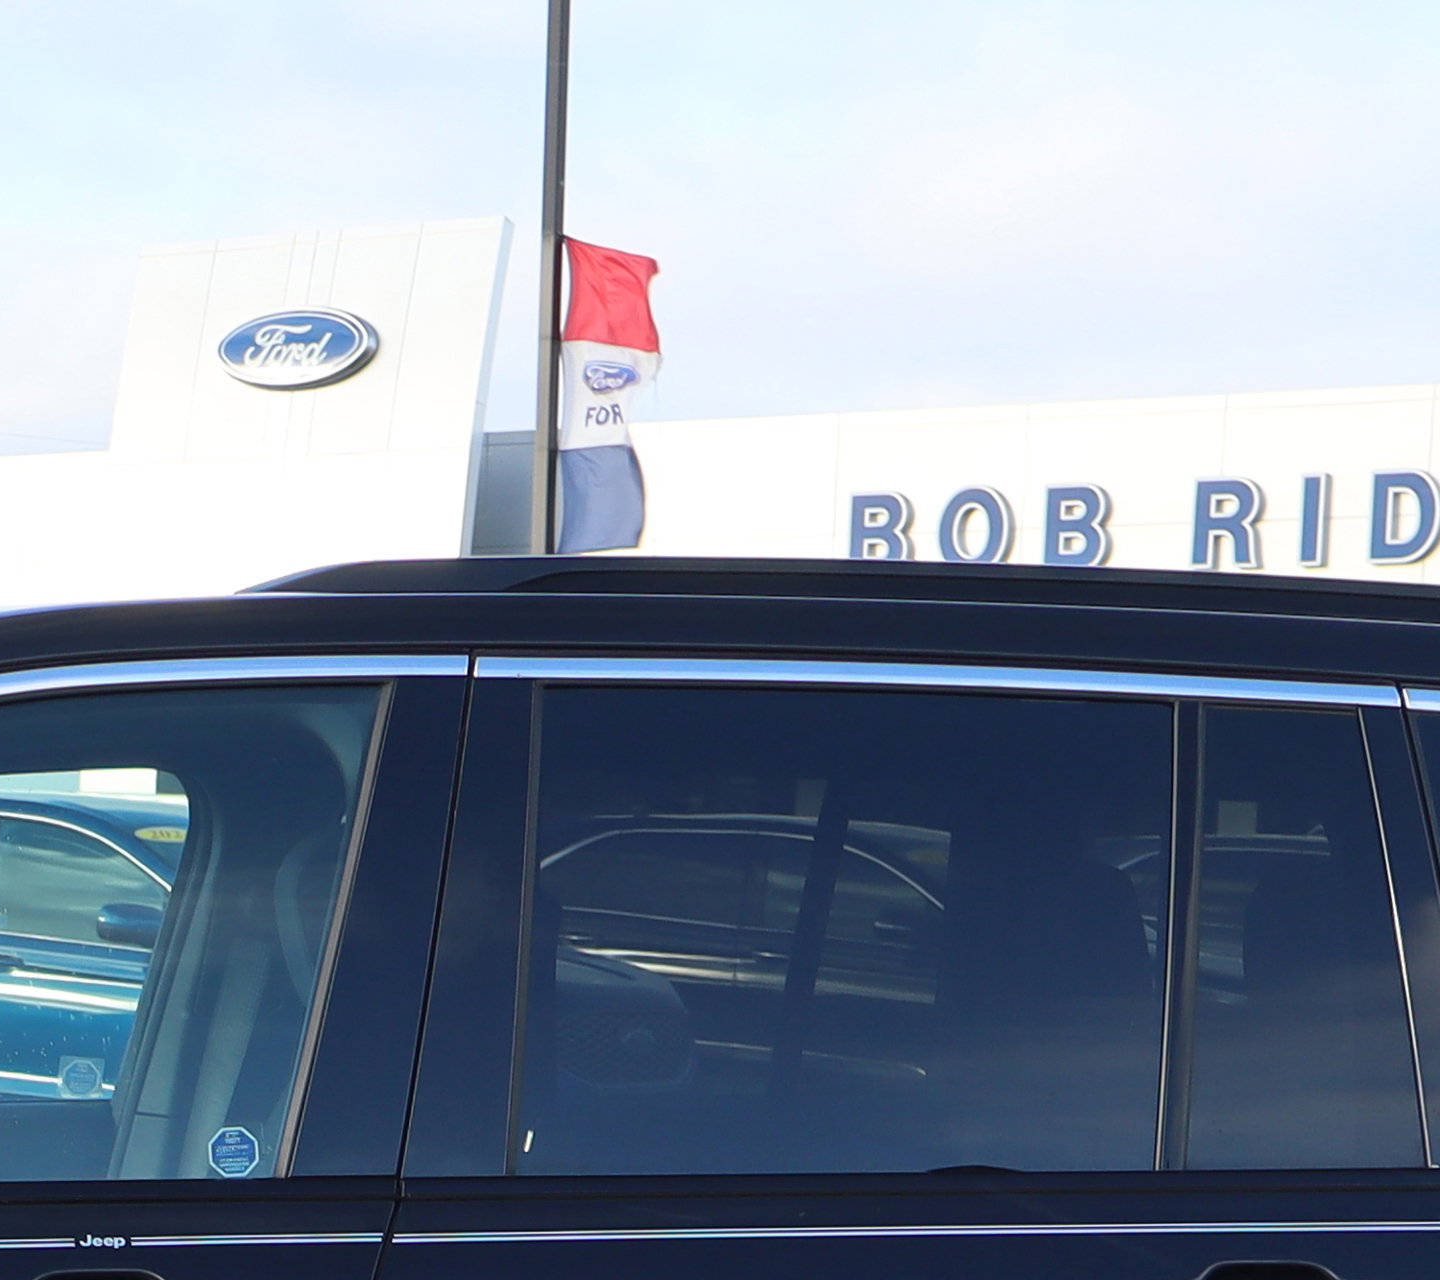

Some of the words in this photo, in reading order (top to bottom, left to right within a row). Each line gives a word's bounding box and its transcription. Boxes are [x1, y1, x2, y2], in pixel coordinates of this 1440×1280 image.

[243, 324, 333, 367] Ford
[584, 403, 625, 428] FOR
[848, 484, 1114, 567] BOB
[79, 1234, 126, 1249] Jeep
